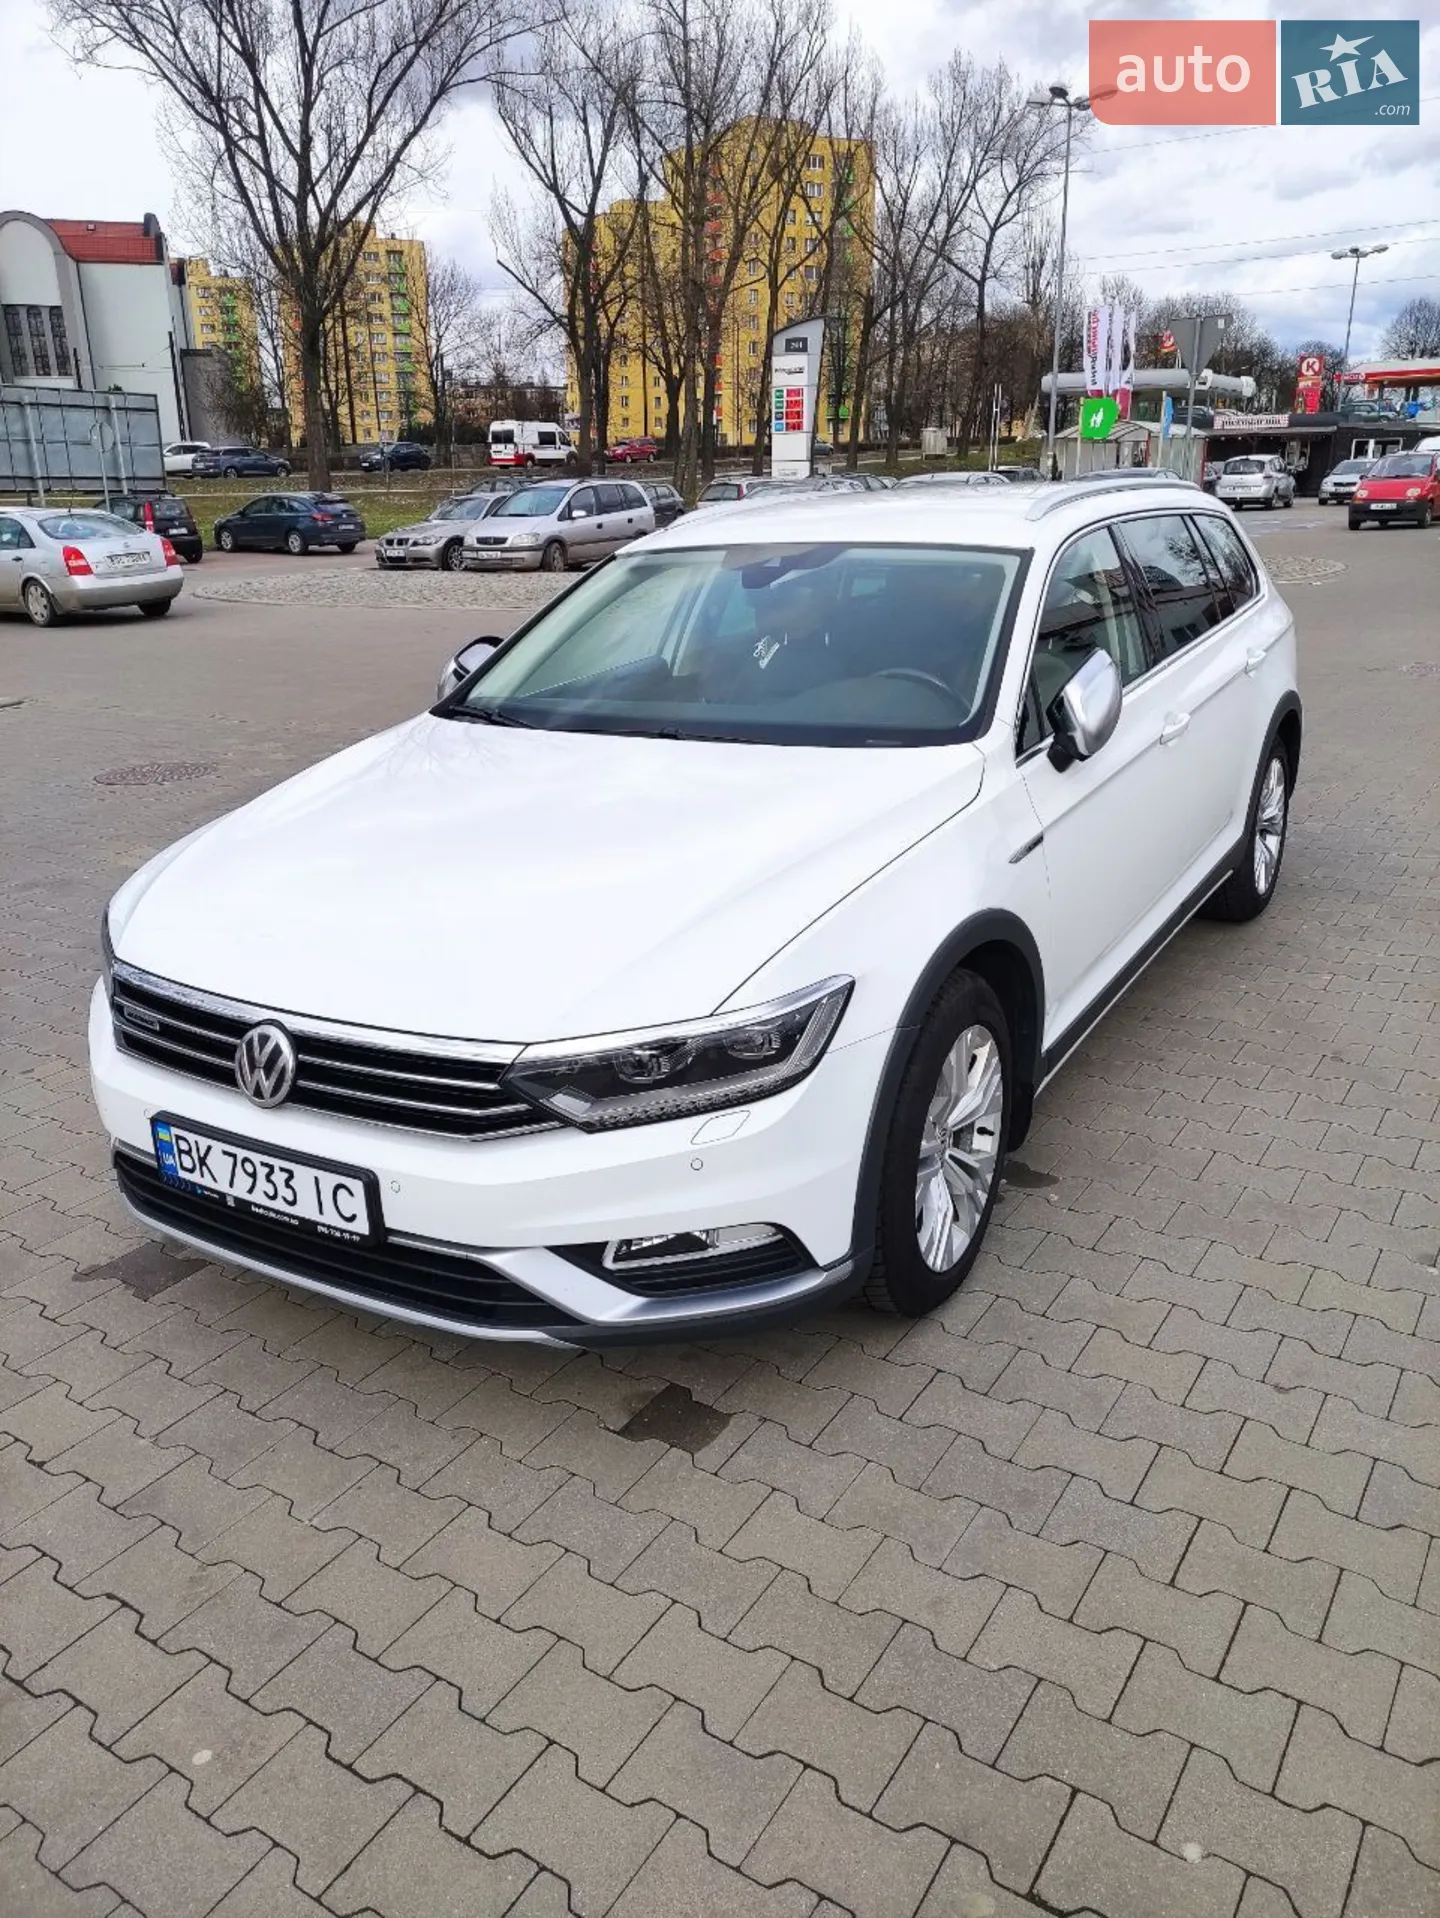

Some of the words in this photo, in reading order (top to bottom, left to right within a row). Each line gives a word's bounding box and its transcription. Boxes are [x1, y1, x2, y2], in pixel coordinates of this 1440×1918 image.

[174, 1134, 218, 1184] BK
[221, 1149, 298, 1207] 7933
[314, 1175, 358, 1223] IC
